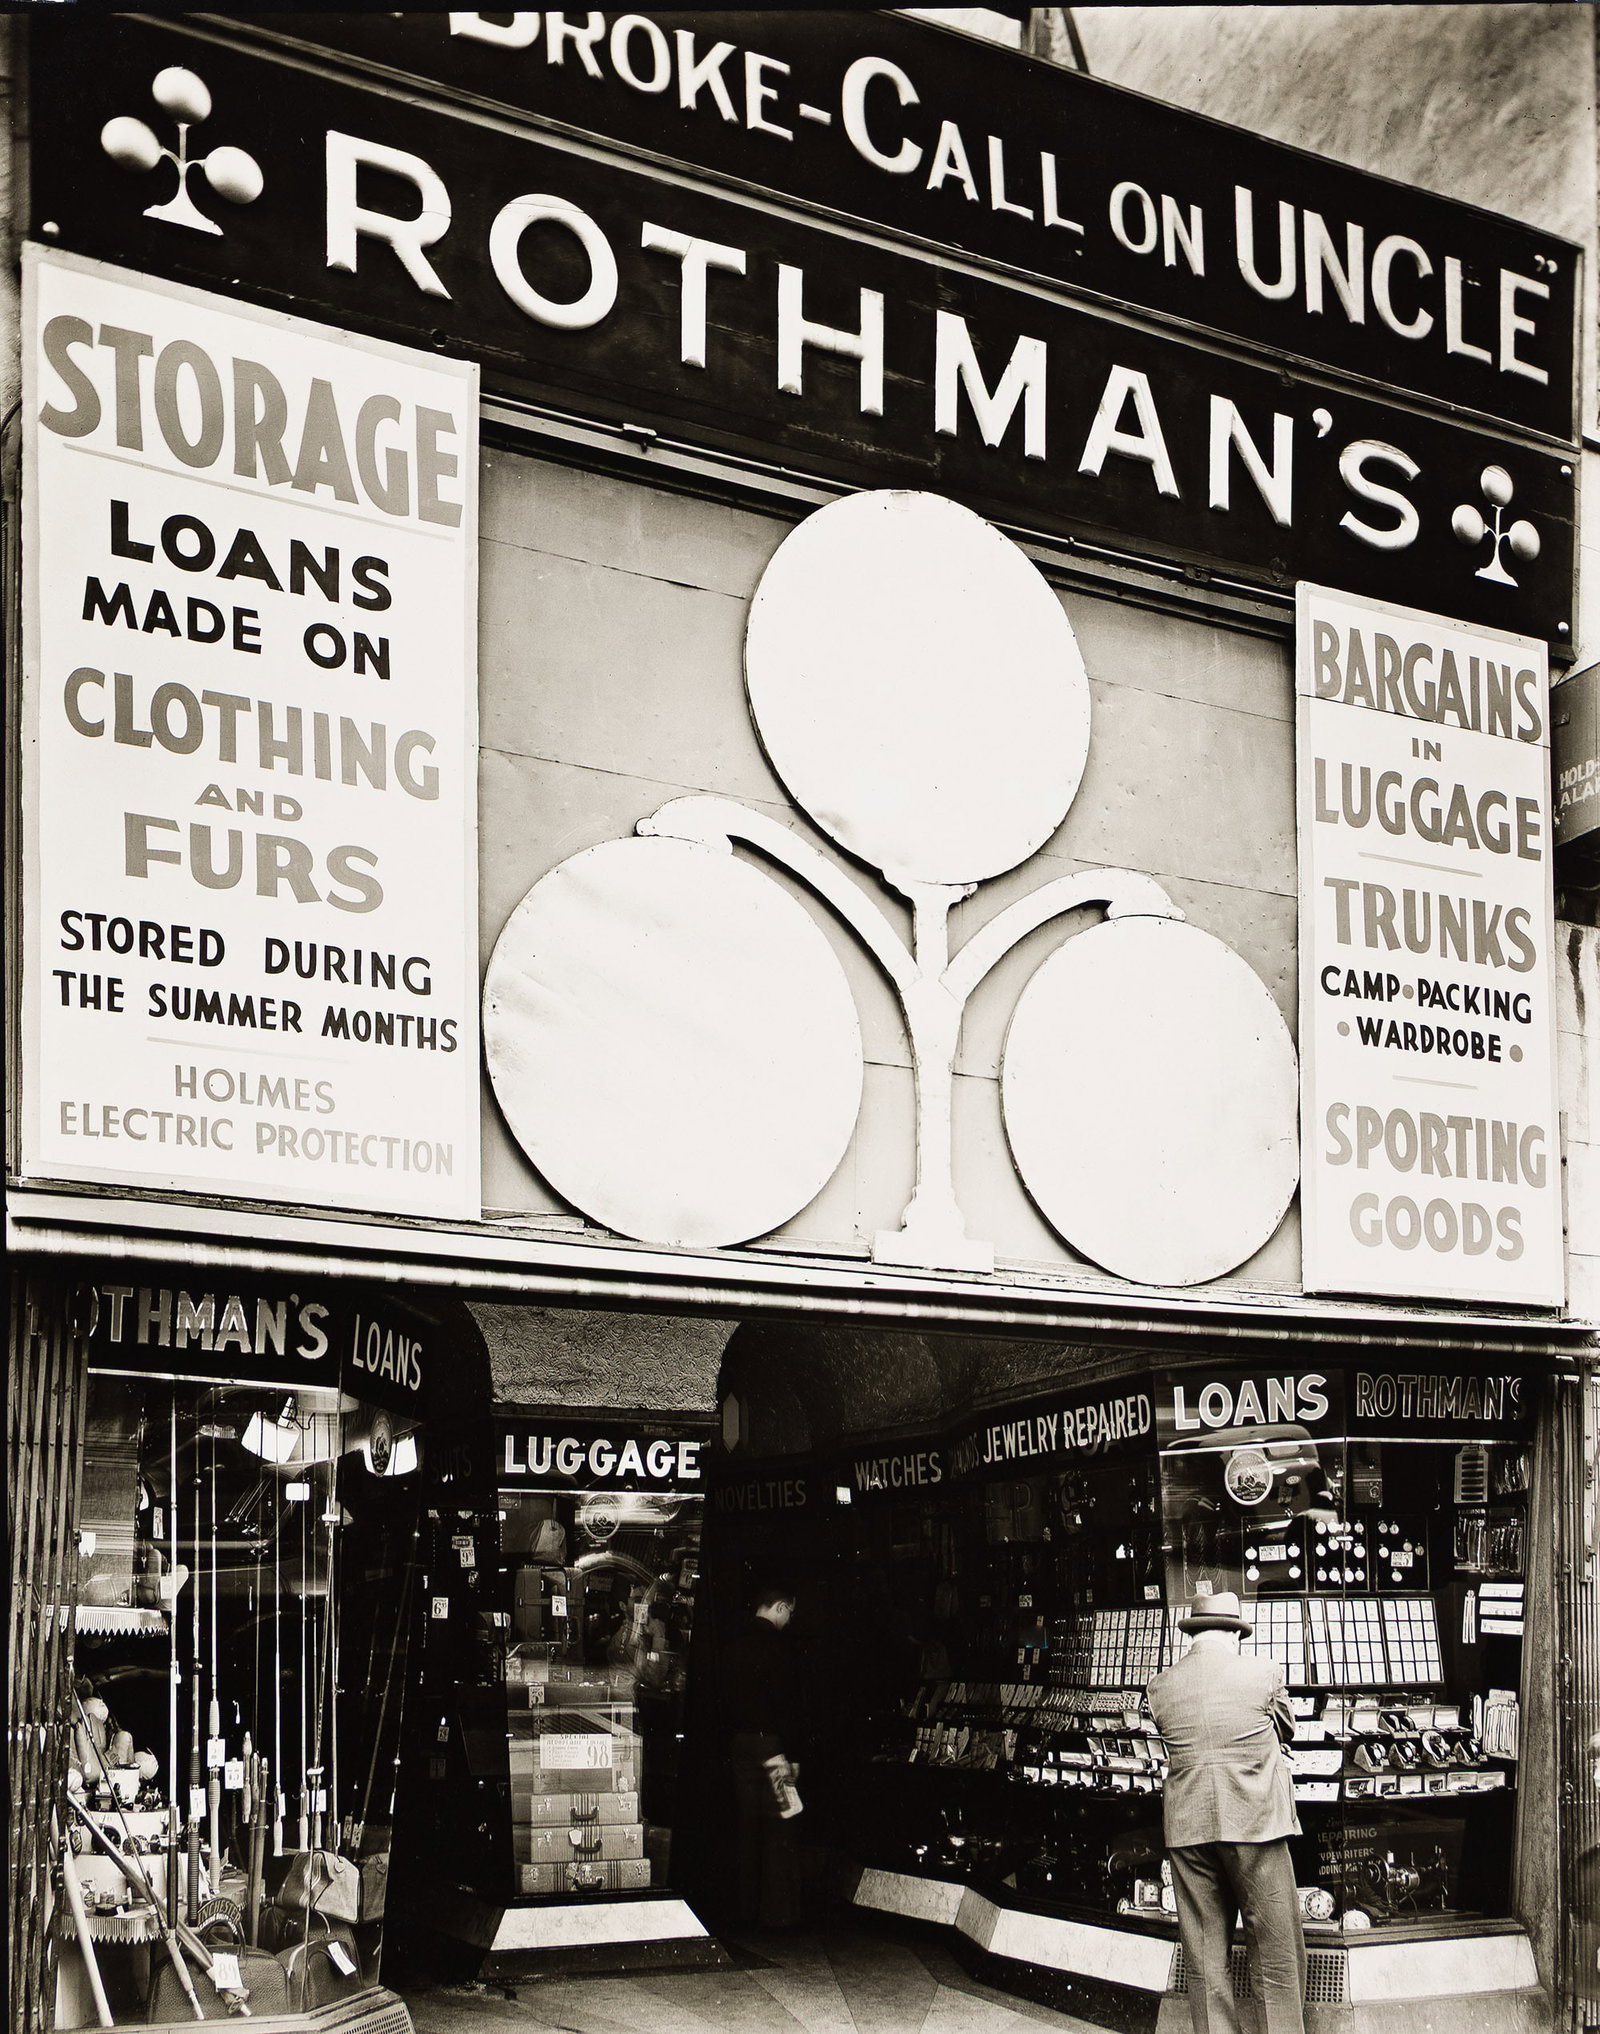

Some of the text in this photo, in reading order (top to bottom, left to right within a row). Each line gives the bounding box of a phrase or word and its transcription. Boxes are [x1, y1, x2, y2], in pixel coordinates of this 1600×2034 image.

[1109, 181, 1205, 277] ON
[326, 130, 1421, 552] ROTHMAN'S
[39, 315, 463, 528] STORAGE
[110, 499, 393, 612] LOANS
[82, 575, 390, 681] MADE ON
[1313, 619, 1543, 743] BARGAINS
[63, 666, 440, 801] CLOTHING
[1412, 737, 1442, 762] IN
[194, 783, 303, 822] AND
[1314, 757, 1542, 862] LUGGAGE
[1559, 757, 1600, 790] HOLD
[124, 811, 384, 914] FURS
[60, 909, 432, 996] STORED DURING
[1324, 876, 1537, 973] TRUNKS
[53, 969, 458, 1054] THE SUMMER MONTHS
[174, 1064, 336, 1114] HOLMES
[60, 1101, 454, 1176] ELECTRIC PROTECTION
[1325, 1102, 1547, 1189] SPORTING
[1350, 1192, 1525, 1261] GOODS
[353, 1314, 423, 1391] LOANS
[983, 1394, 1151, 1464] JEWELRY REPAIRED
[1173, 1374, 1329, 1431] LOANS
[504, 1435, 700, 1478] LUGGAGE
[854, 1452, 942, 1492] WATCHES
[715, 1480, 807, 1513] NOVELTIES
[587, 1744, 609, 1768] 98
[1318, 1848, 1375, 1862] YPEWRITERS
[198, 1899, 241, 1926] INCHESTER
